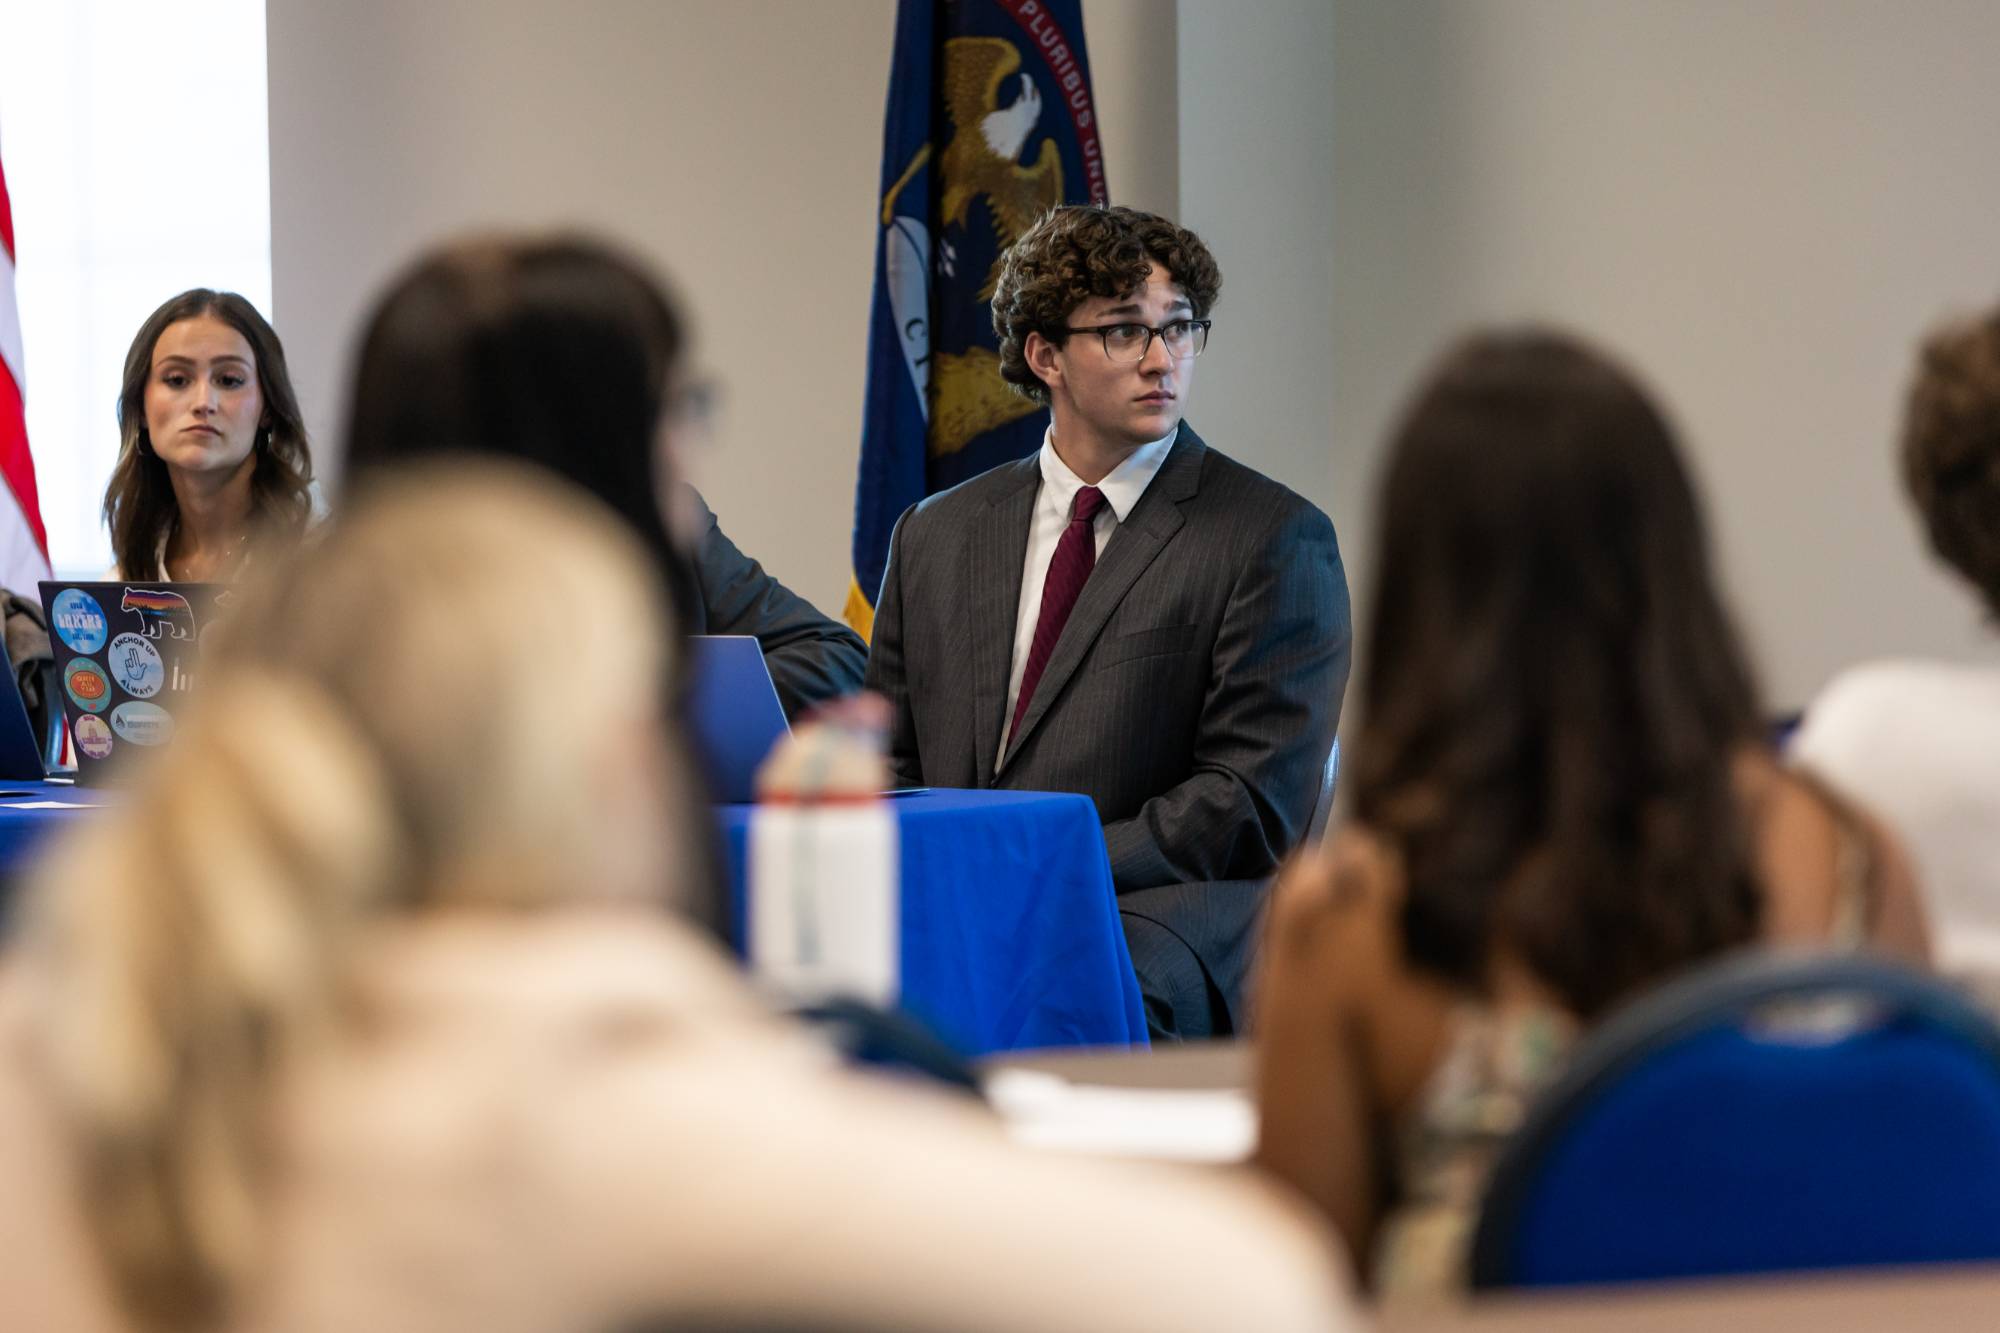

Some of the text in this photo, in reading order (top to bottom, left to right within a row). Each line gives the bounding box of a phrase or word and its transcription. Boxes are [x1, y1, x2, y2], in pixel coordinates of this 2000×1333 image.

[1018, 0, 1106, 204] PLURIBUS UNU
[114, 636, 156, 657] ANCHOR UP
[120, 679, 154, 696] ALWAYS
